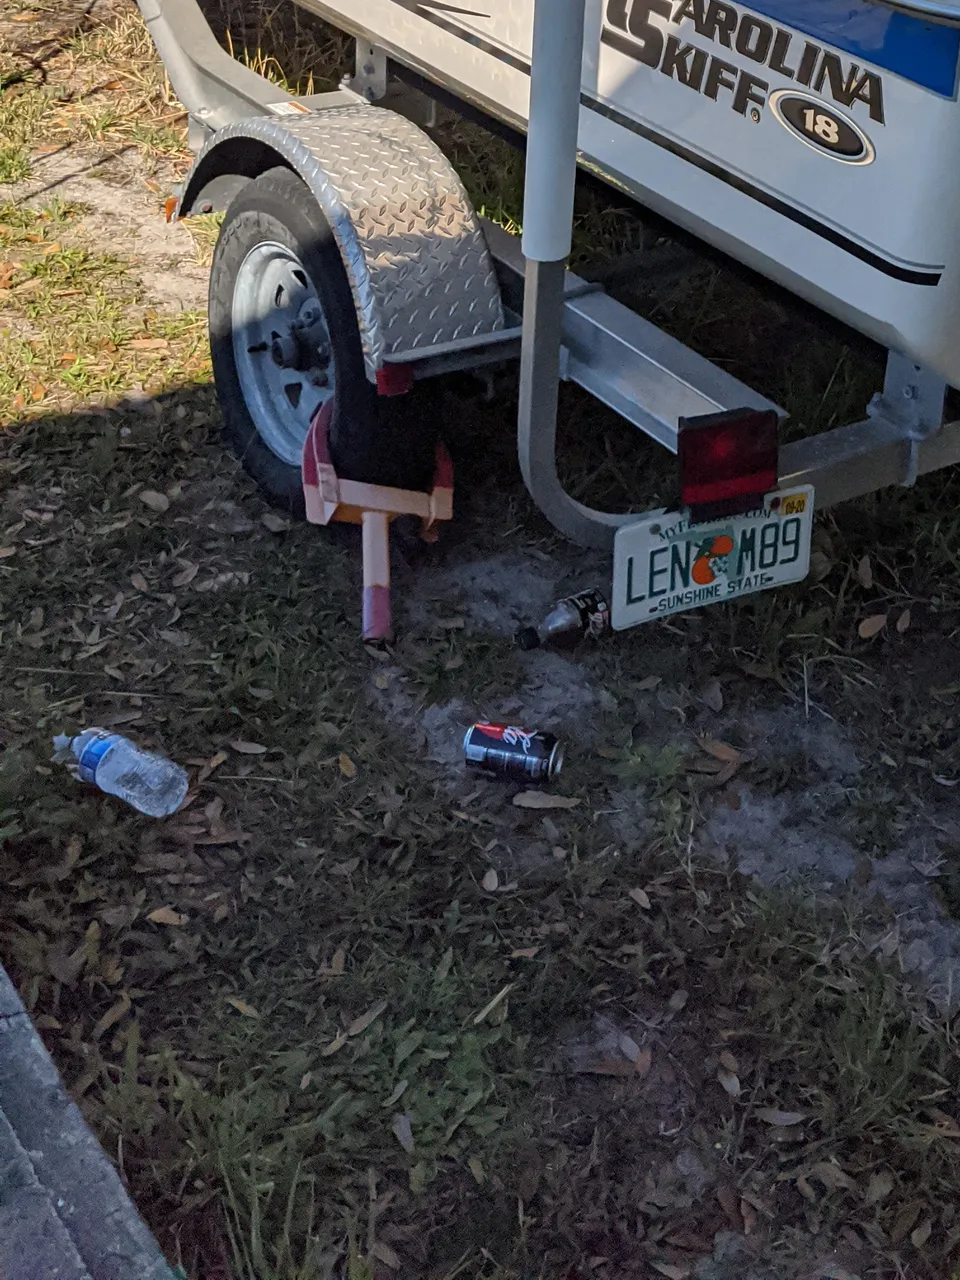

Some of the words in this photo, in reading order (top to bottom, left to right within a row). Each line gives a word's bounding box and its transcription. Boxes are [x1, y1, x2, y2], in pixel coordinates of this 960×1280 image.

[802, 107, 839, 144] 18
[626, 540, 691, 606] LEN
[736, 517, 801, 577] M89
[658, 583, 721, 613] SUNSHINE
[726, 571, 768, 596] STATE
